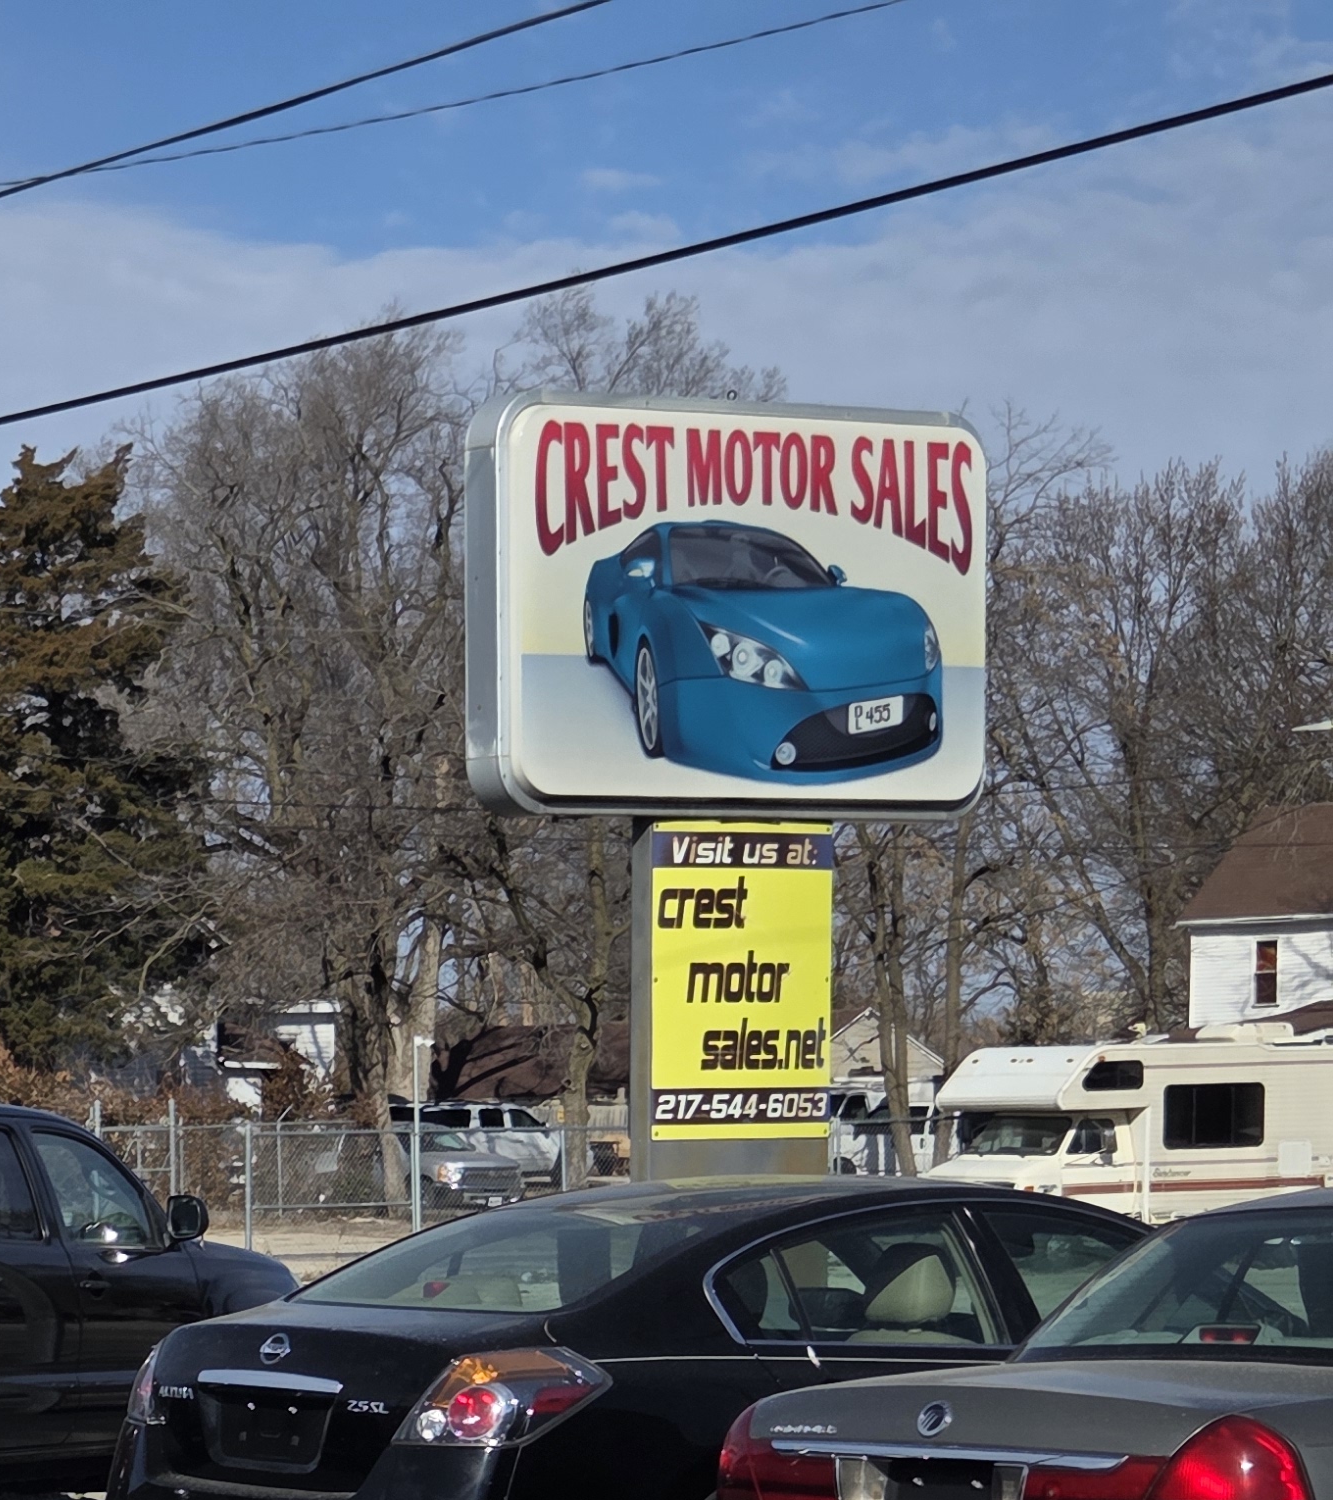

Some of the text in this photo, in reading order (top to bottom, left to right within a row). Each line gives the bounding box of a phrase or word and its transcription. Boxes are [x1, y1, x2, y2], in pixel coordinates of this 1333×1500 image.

[535, 419, 973, 576] CREST MOTOR SALES
[866, 703, 890, 724] 455
[671, 836, 734, 865] Visit
[742, 843, 779, 865] us
[657, 876, 748, 930] crest
[686, 950, 790, 1004] motor
[700, 1017, 826, 1070] sales.net
[655, 1093, 828, 1120] 217-544-6053
